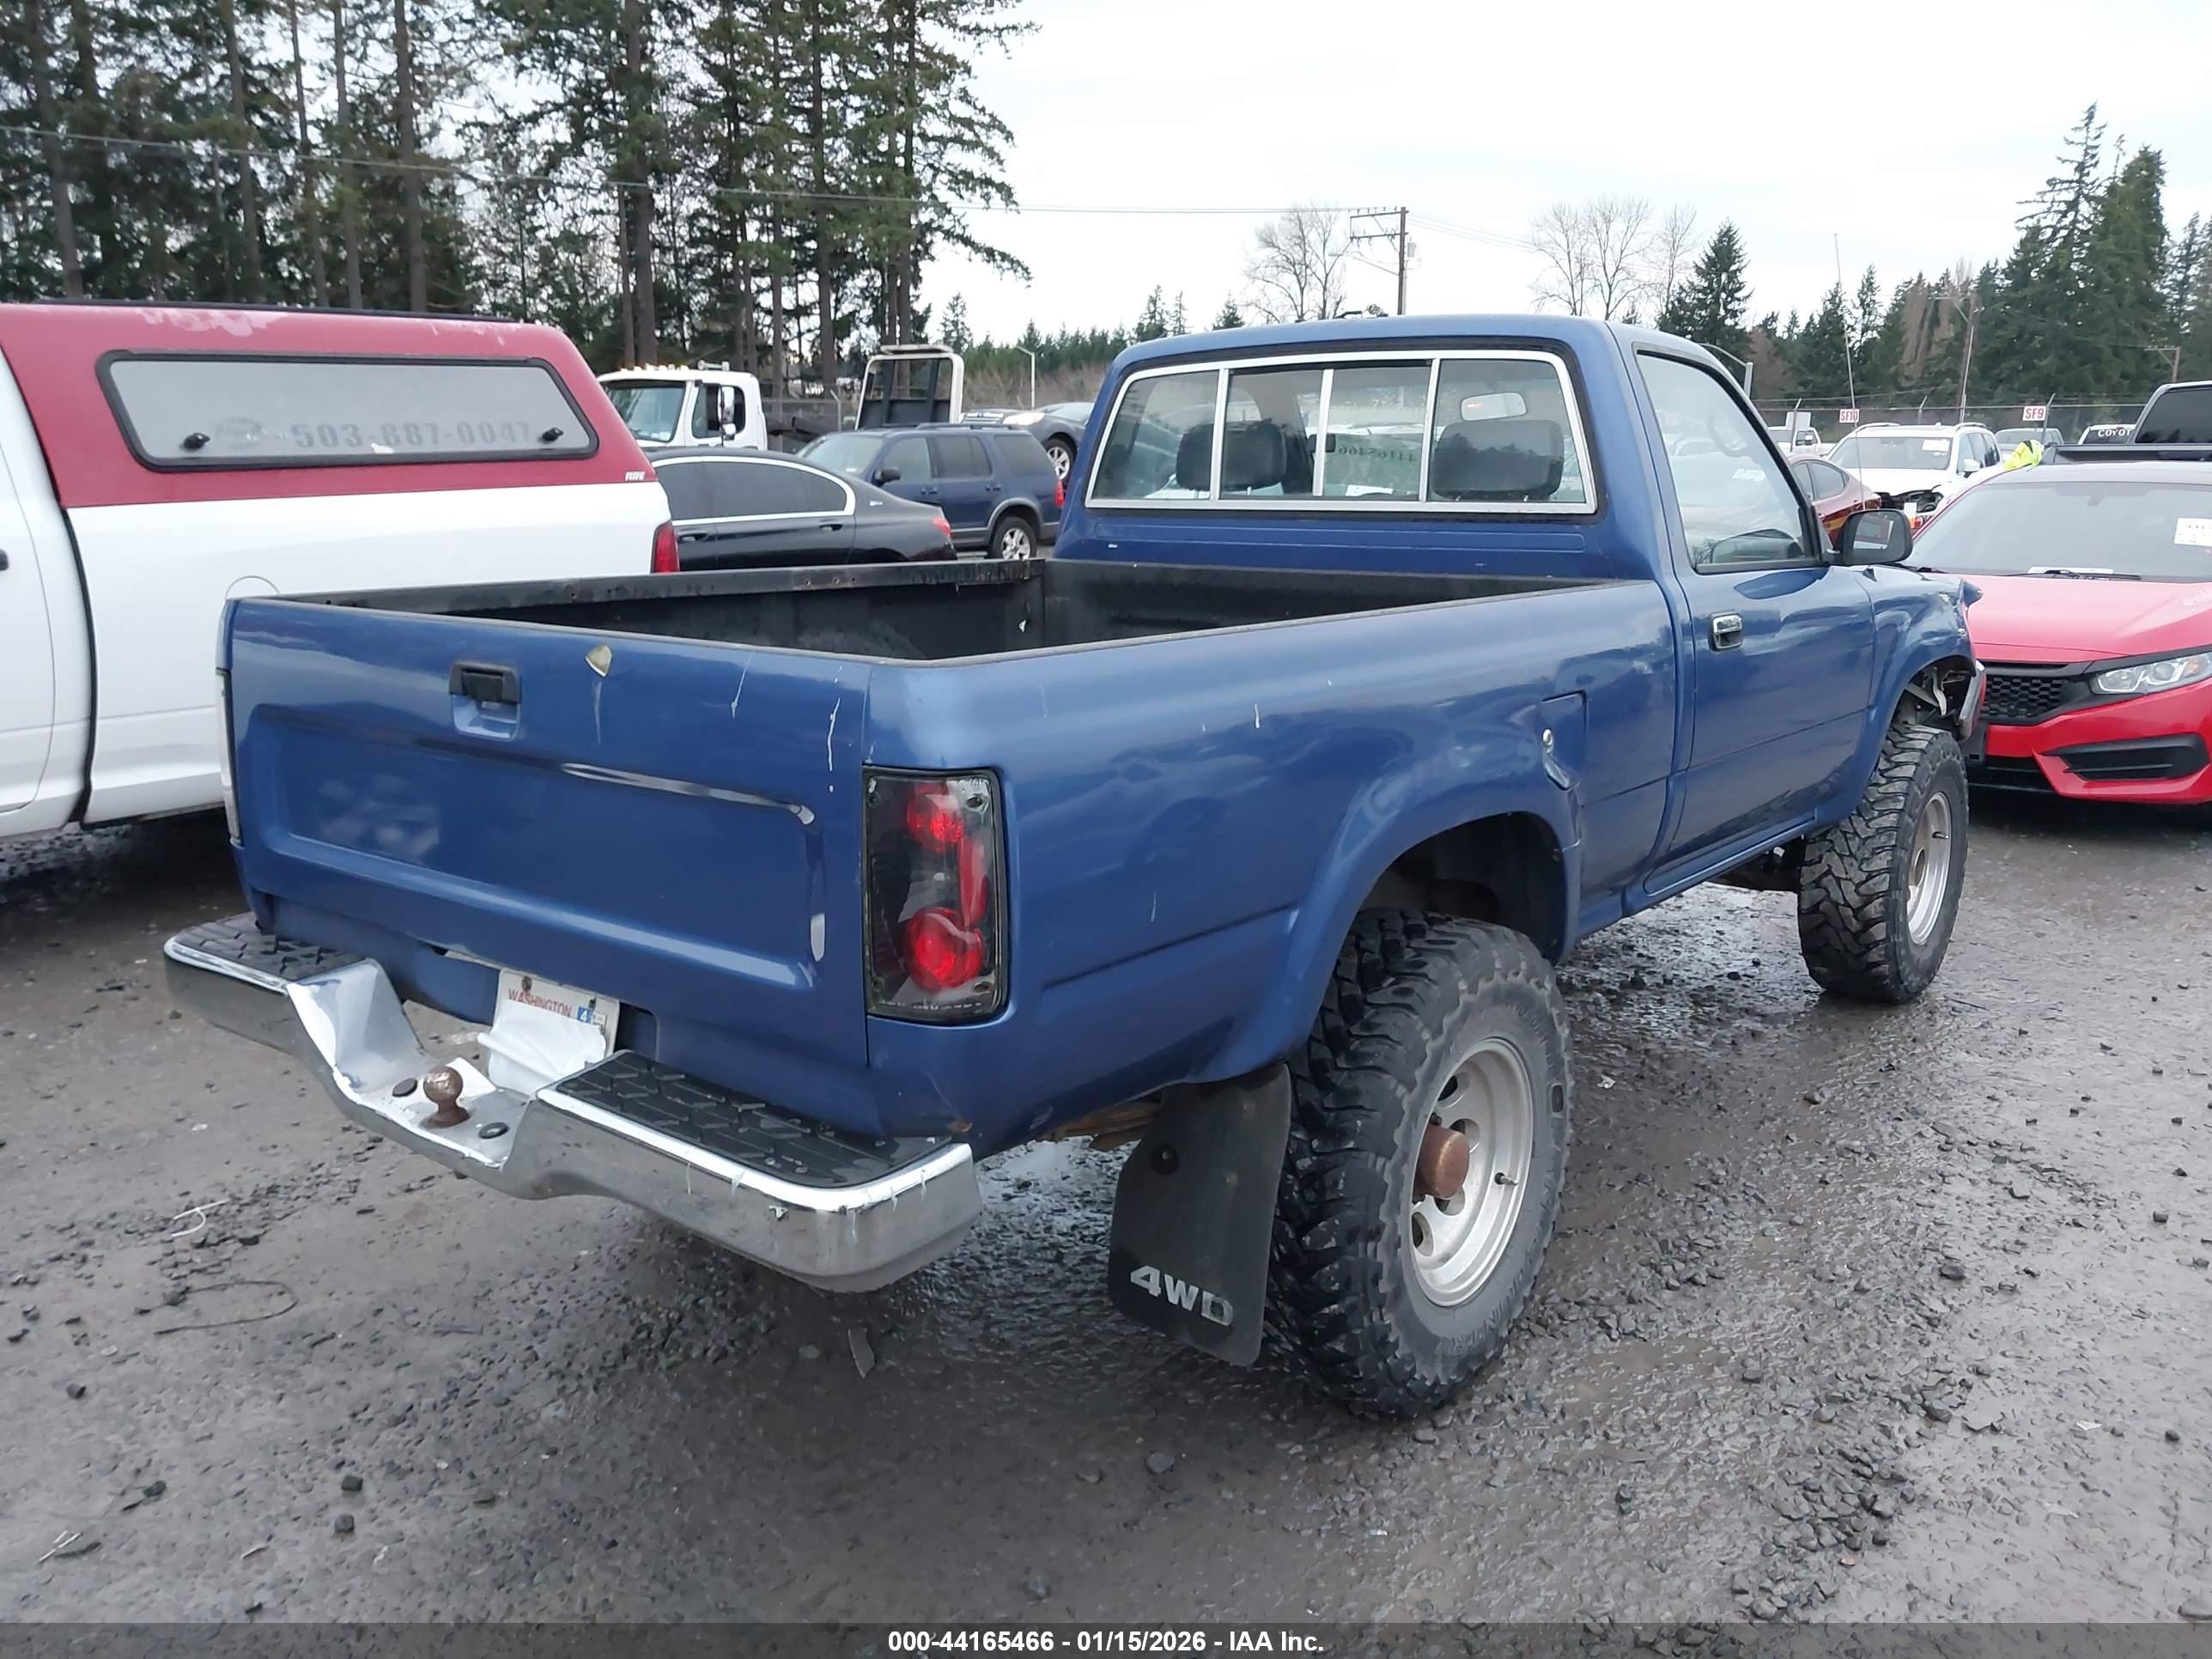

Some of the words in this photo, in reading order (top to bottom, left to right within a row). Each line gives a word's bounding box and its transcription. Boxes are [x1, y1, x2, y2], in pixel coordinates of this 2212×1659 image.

[1840, 410, 1858, 421] SF10
[2025, 408, 2045, 419] SF9
[290, 422, 529, 447] 503-887-0047
[508, 988, 572, 1018] WASHINGTON
[1130, 1265, 1234, 1327] 4WD
